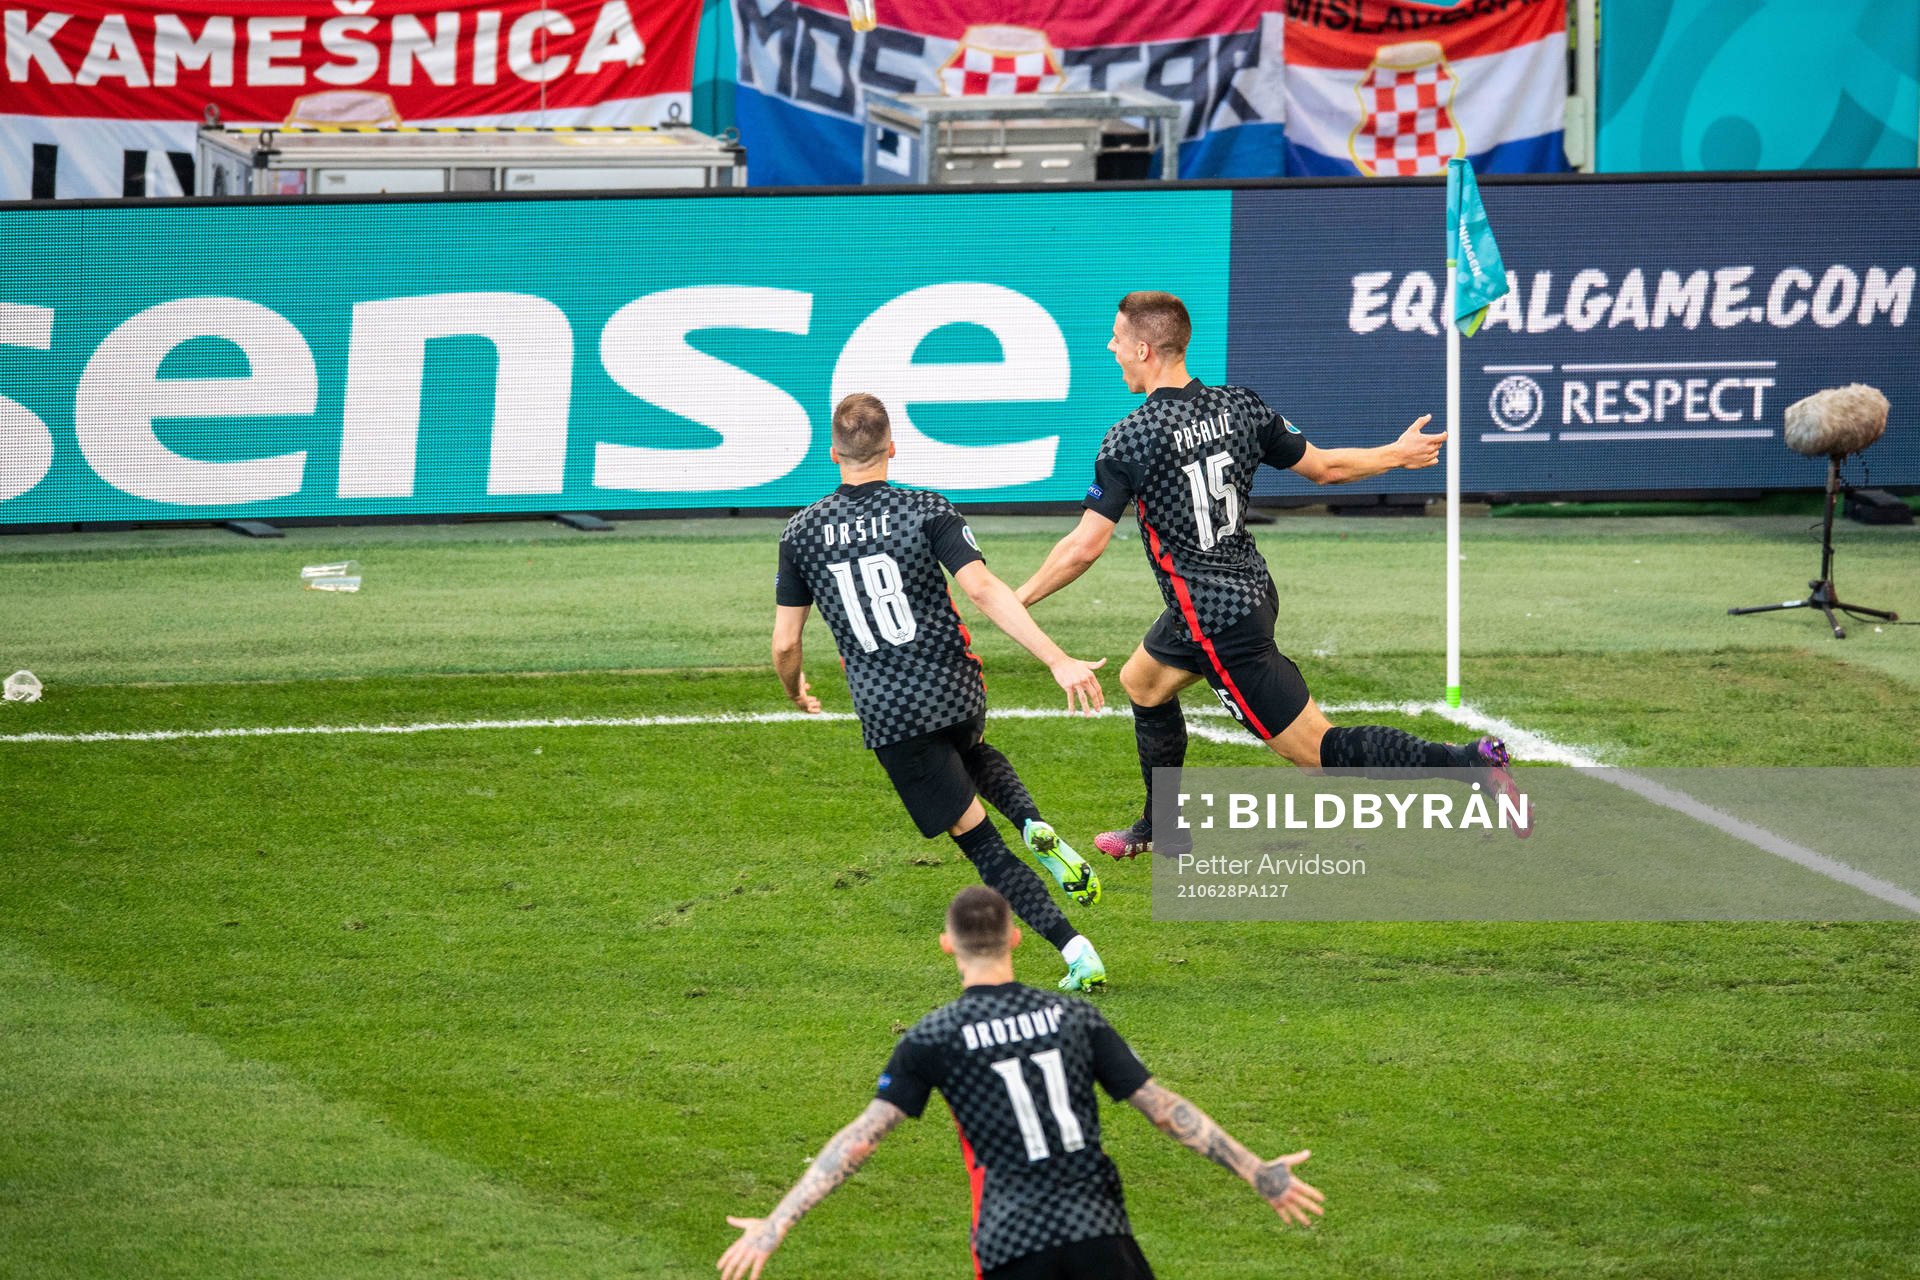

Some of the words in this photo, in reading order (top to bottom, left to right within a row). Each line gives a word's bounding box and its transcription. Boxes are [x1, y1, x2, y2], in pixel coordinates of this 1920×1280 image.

[4, 0, 646, 88] KAMEŠNICA
[1348, 265, 1917, 336] EQALGAME.COM
[0, 281, 1071, 506] ense
[1173, 408, 1234, 452] PAŠALIĆ
[1561, 377, 1775, 425] RESPECT
[823, 511, 892, 545] DRŠIĆ
[1181, 450, 1238, 551] 15
[826, 553, 918, 653] 18
[990, 1048, 1085, 1161] 11
